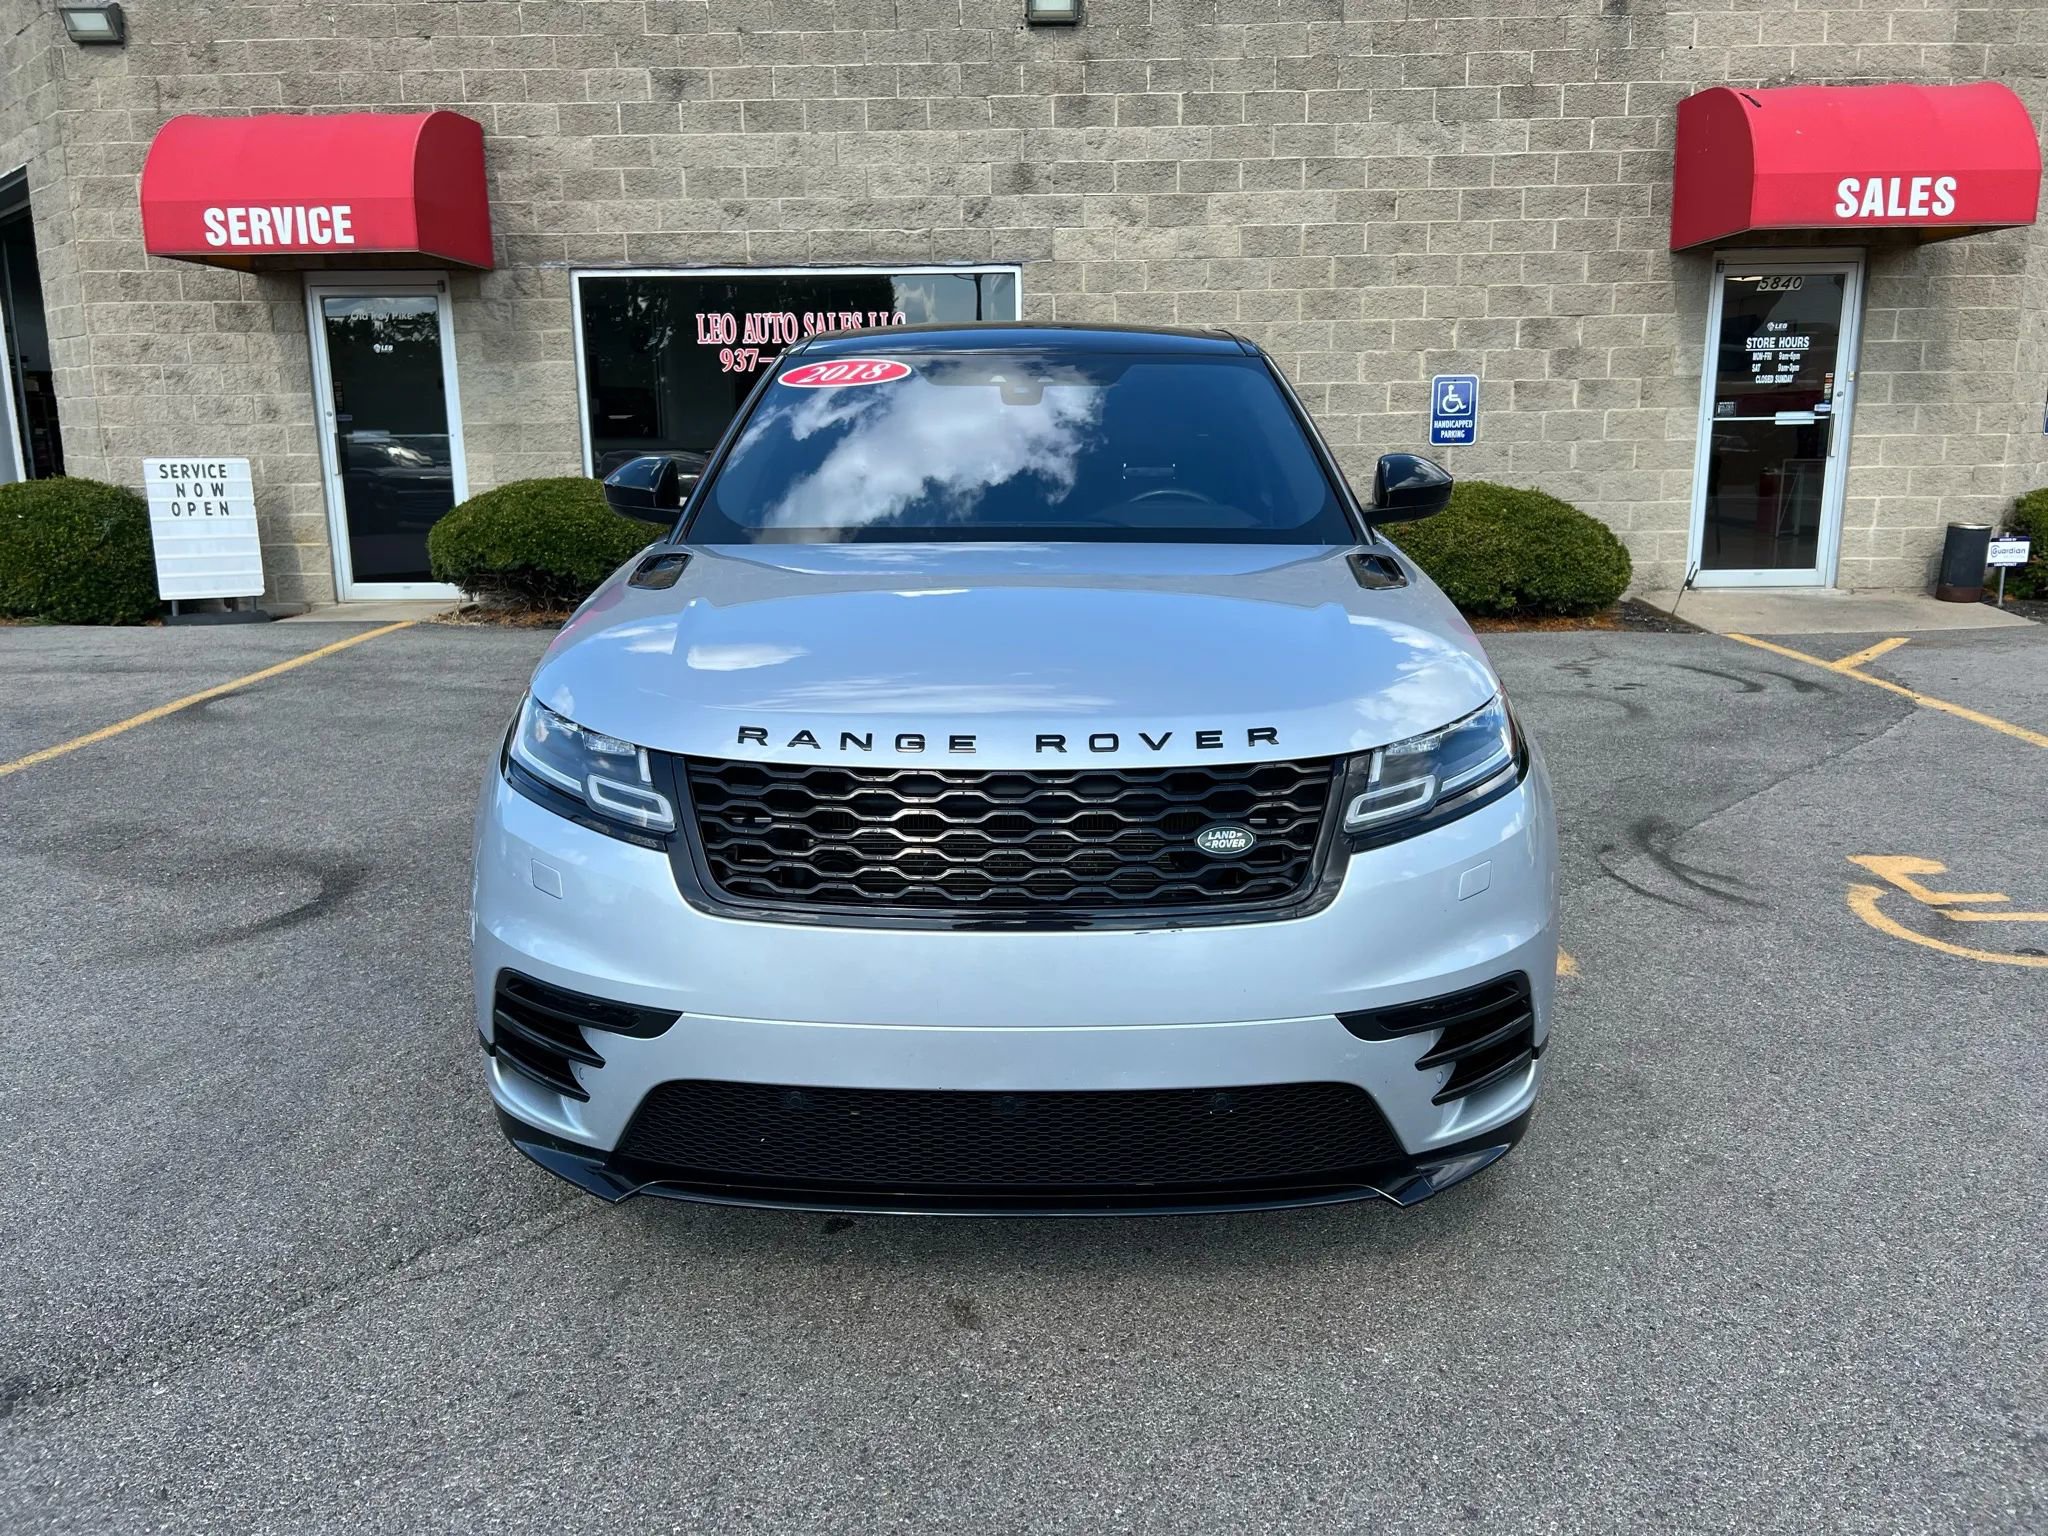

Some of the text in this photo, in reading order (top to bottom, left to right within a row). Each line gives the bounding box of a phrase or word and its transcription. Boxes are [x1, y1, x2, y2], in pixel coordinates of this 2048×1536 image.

[1835, 176, 1957, 218] SALES
[203, 206, 355, 246] SERVICE
[1760, 277, 1803, 290] 5840
[350, 311, 369, 320] Old
[391, 311, 413, 320] Pike
[696, 313, 737, 344] LEO
[743, 312, 798, 344] AUTO
[1746, 336, 1810, 348] STORE HOURS
[719, 348, 785, 372] 937-
[1752, 352, 1773, 361] MON-FRI
[796, 363, 891, 383] 2018
[1752, 363, 1761, 372] SAT
[1755, 375, 1793, 383] CLOSED SUNDAY
[1433, 420, 1473, 428] HANDICAPPED
[1440, 430, 1466, 439] PARKING
[159, 464, 227, 479] SERVICE
[176, 482, 224, 498] NOW
[171, 501, 229, 516] OPEN
[1990, 545, 2026, 557] Guardian
[738, 726, 1279, 753] RANGE ROVER
[1208, 830, 1236, 840] LAND
[1211, 838, 1246, 848] ROVER
